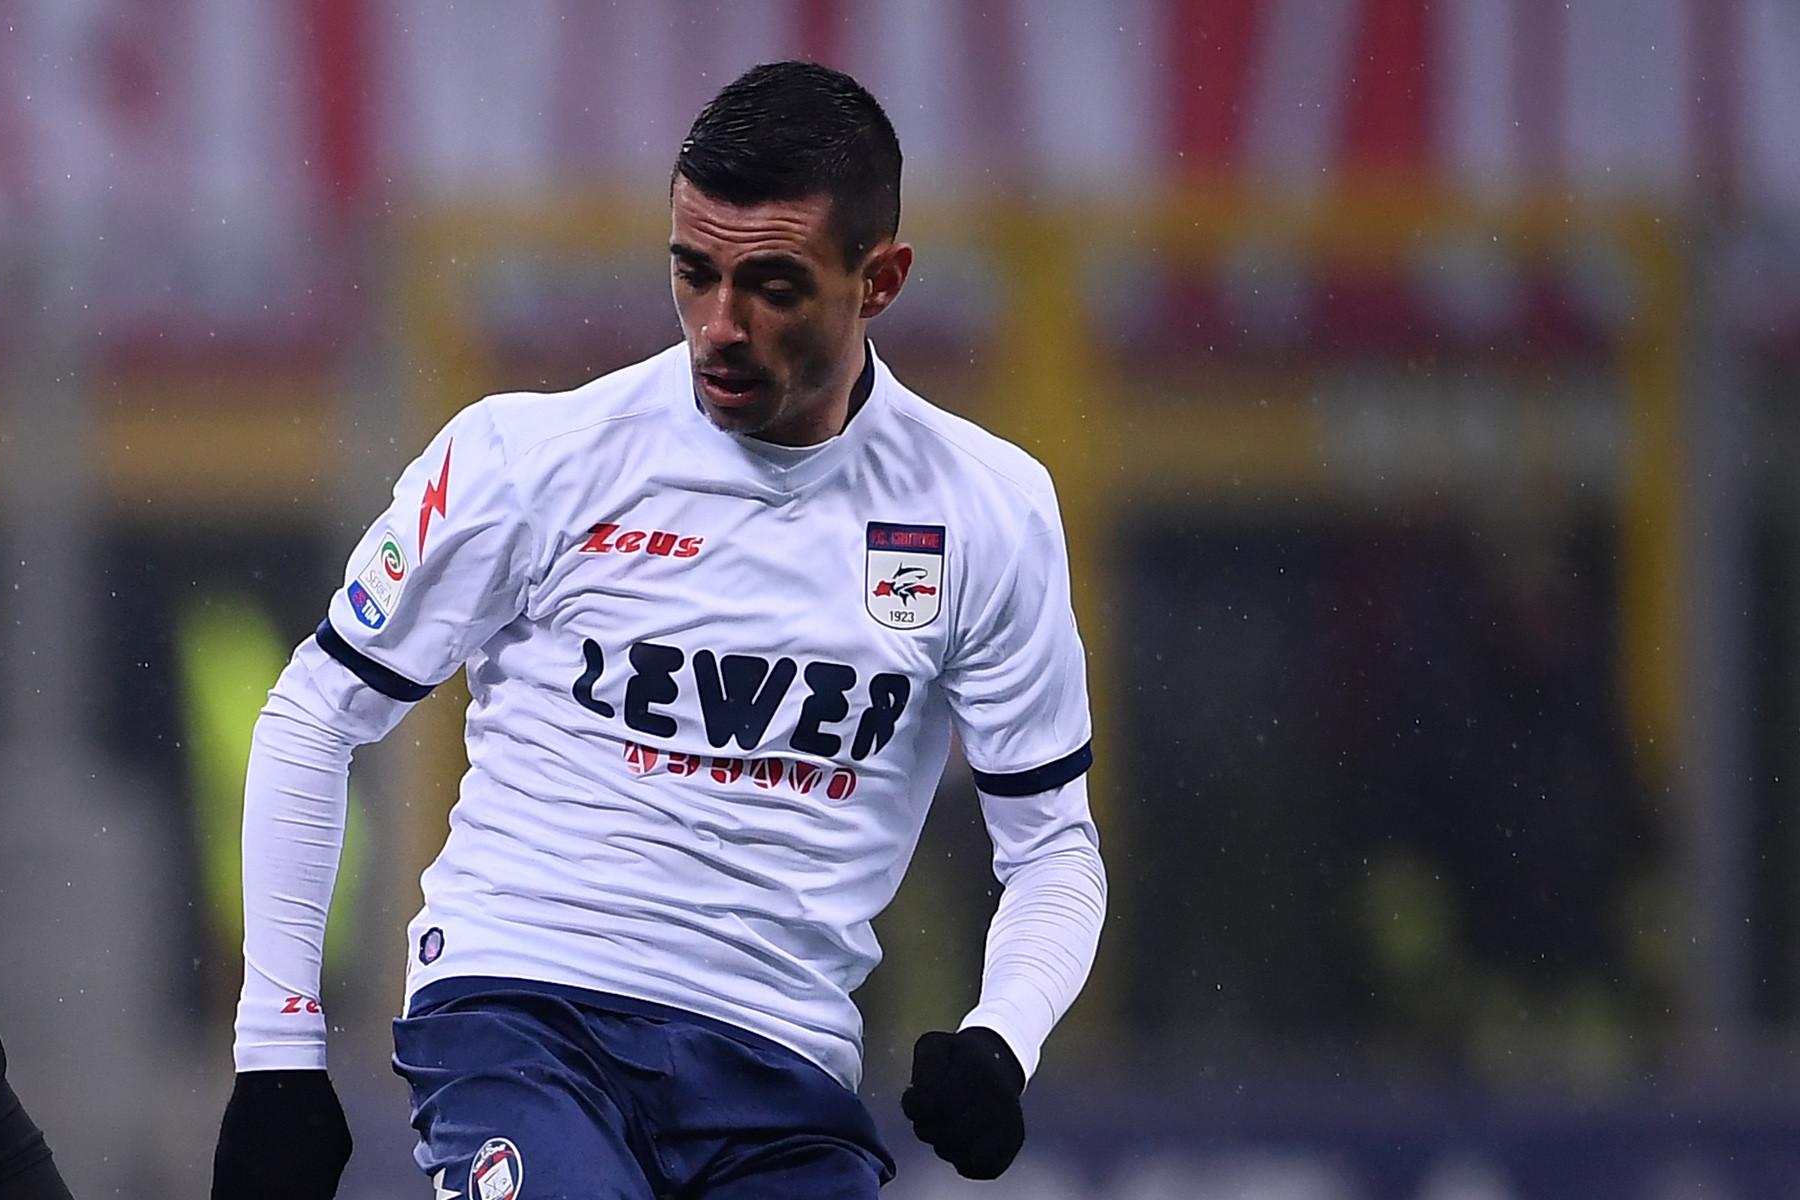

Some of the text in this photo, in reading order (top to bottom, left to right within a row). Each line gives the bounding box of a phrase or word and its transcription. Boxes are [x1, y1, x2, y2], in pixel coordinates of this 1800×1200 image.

[578, 523, 704, 558] Zeus
[361, 599, 381, 626] TIM
[889, 611, 915, 623] 1923
[572, 638, 911, 761] LEWER
[280, 995, 320, 1014] Ze
